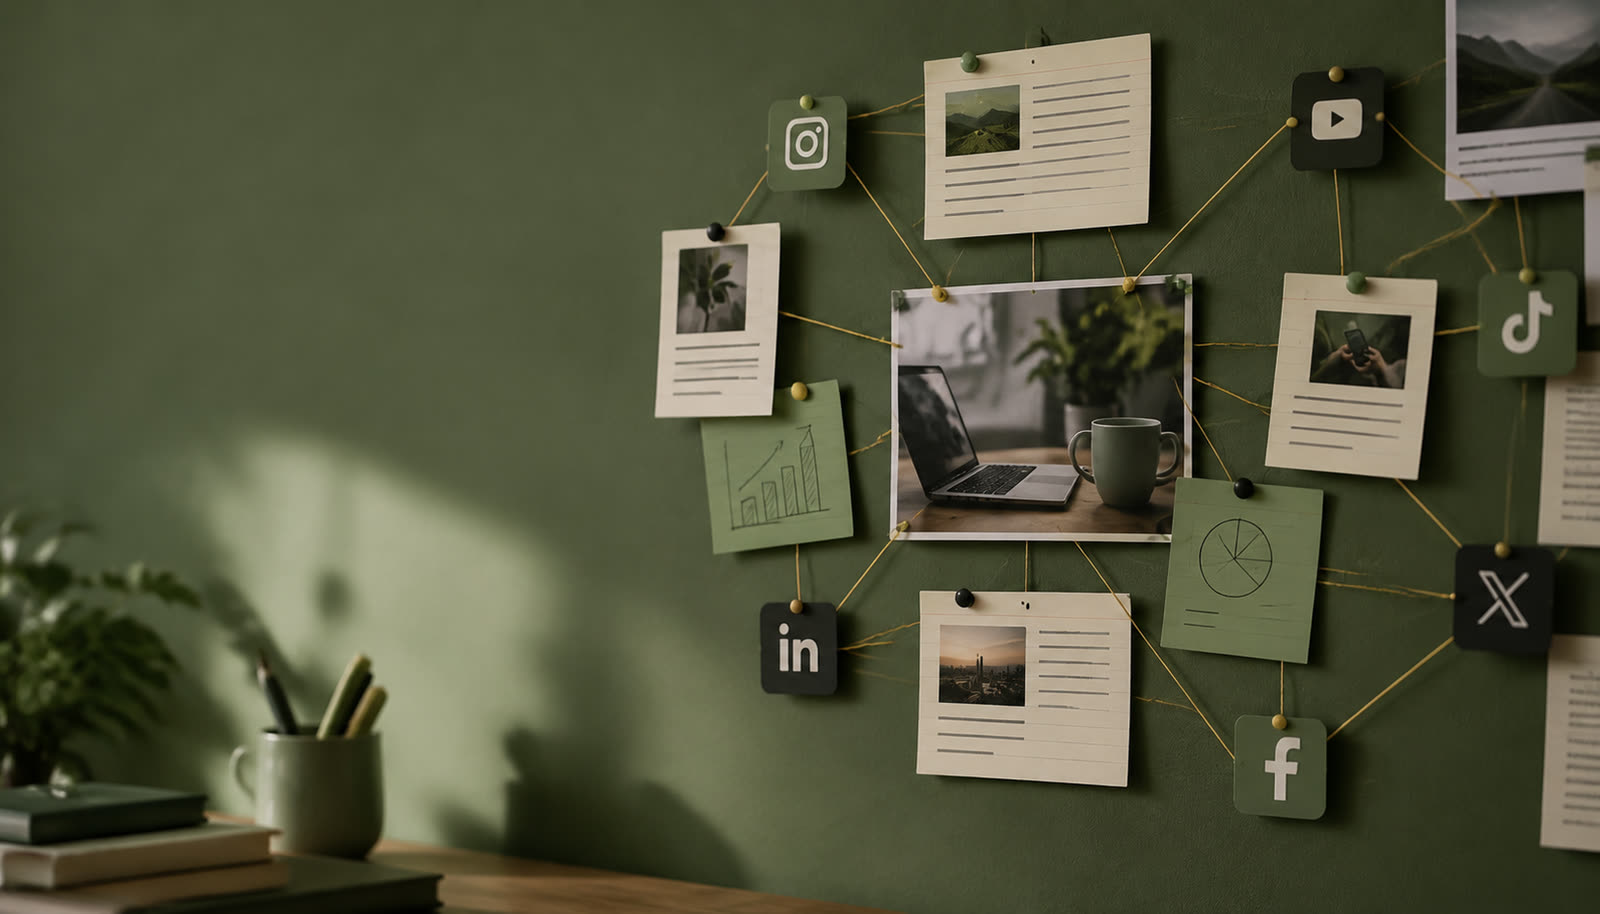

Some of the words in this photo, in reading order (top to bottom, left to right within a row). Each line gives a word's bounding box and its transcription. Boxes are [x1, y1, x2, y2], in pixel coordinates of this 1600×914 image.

[1478, 571, 1529, 628] X
[778, 623, 819, 673] in
[1264, 736, 1301, 801] f
